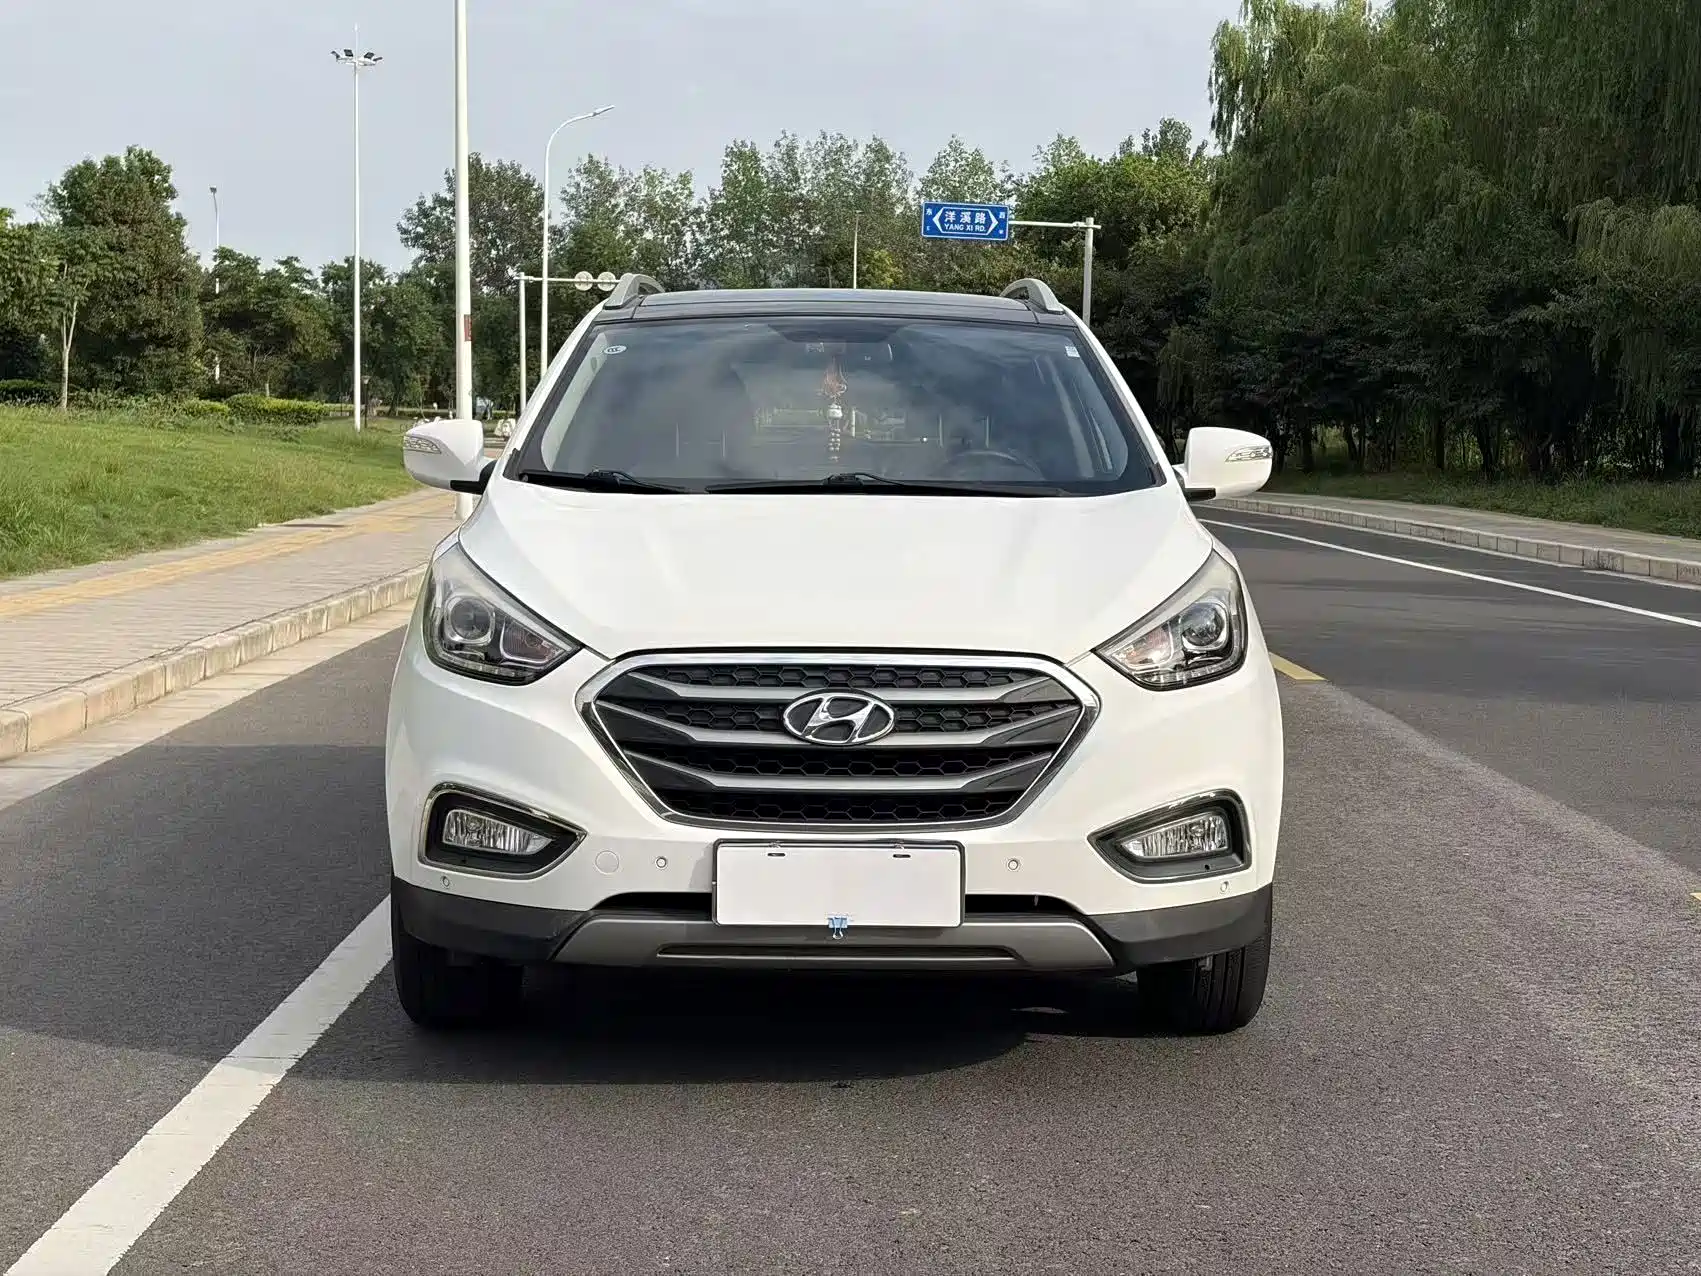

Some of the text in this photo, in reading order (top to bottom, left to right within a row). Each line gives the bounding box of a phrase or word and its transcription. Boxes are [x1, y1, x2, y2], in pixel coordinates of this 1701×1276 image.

[944, 210, 986, 224] 洋溪路
[944, 223, 964, 231] YANG
[975, 224, 986, 232] RD.
